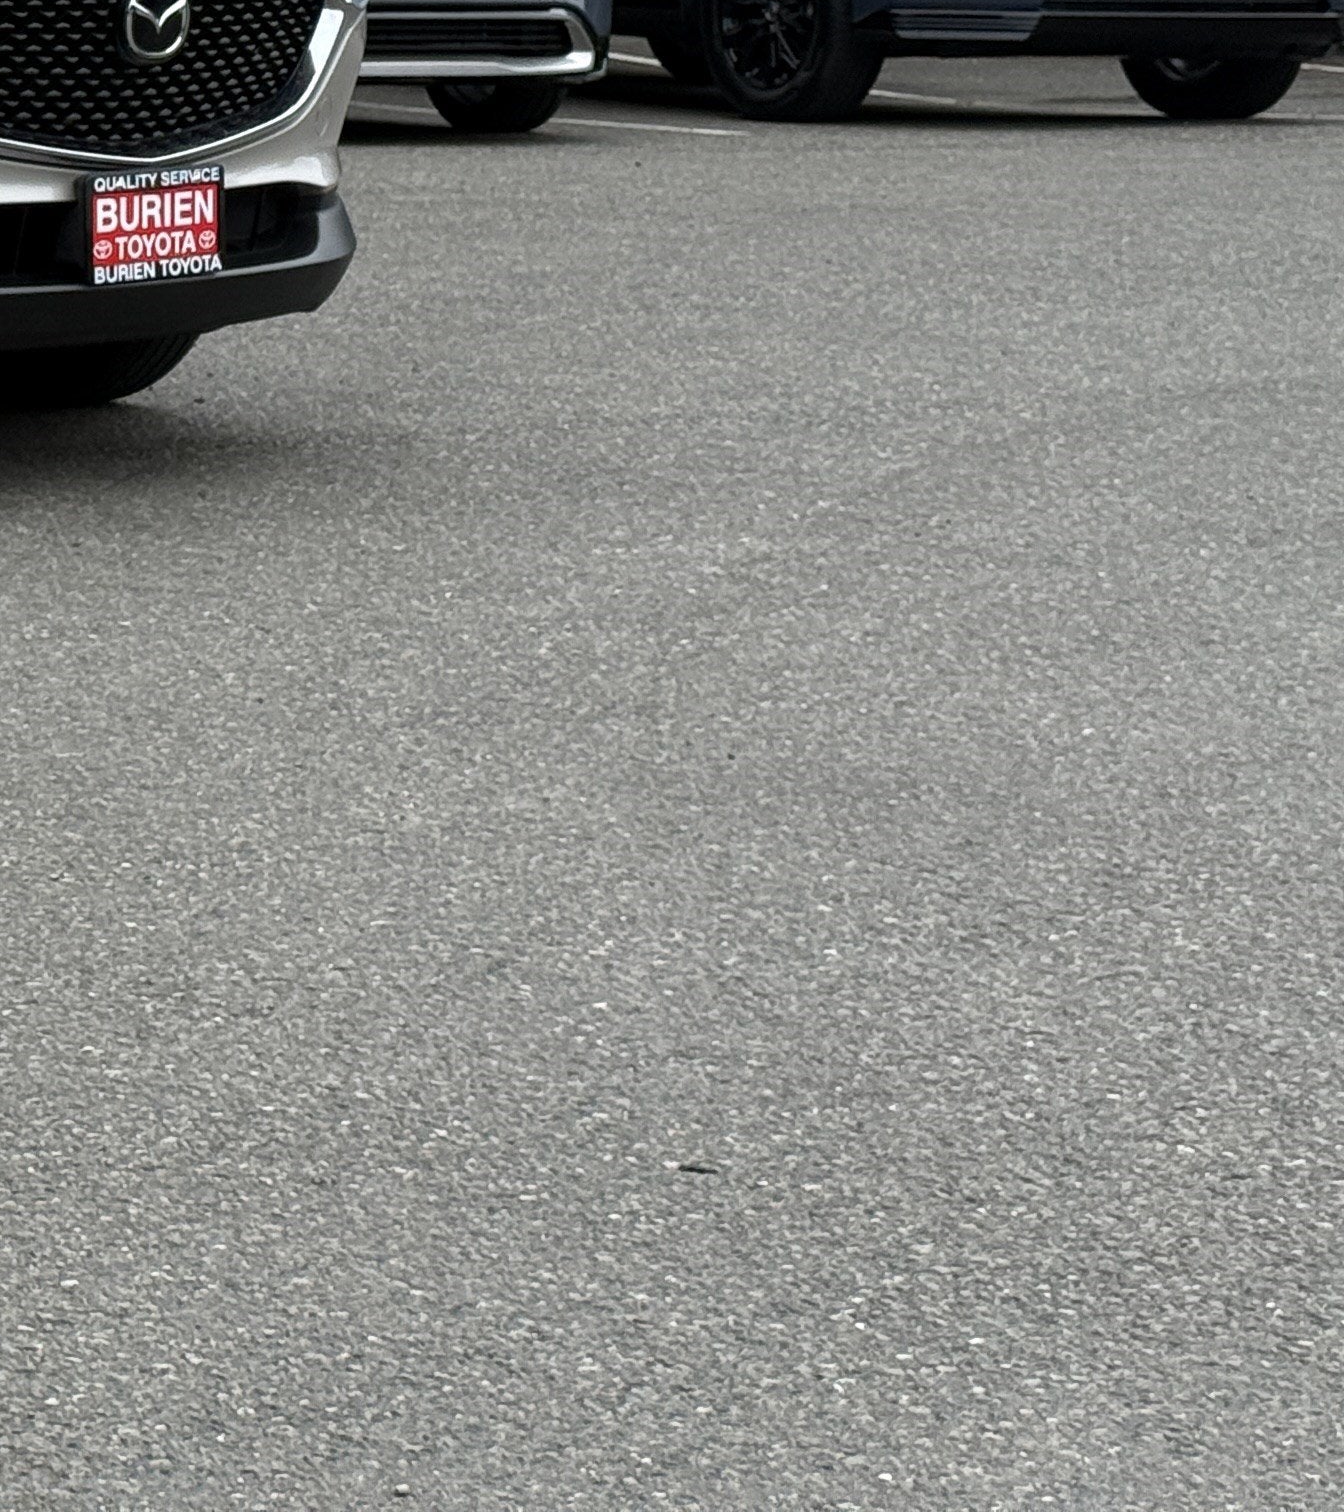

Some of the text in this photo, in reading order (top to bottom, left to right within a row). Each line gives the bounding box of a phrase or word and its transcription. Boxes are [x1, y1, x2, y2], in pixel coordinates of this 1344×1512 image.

[94, 166, 220, 193] QUALITY SERVCE
[96, 189, 213, 234] BURIEN
[115, 230, 197, 261] TOYOTA
[94, 253, 223, 285] BURIEN TOYOTA
